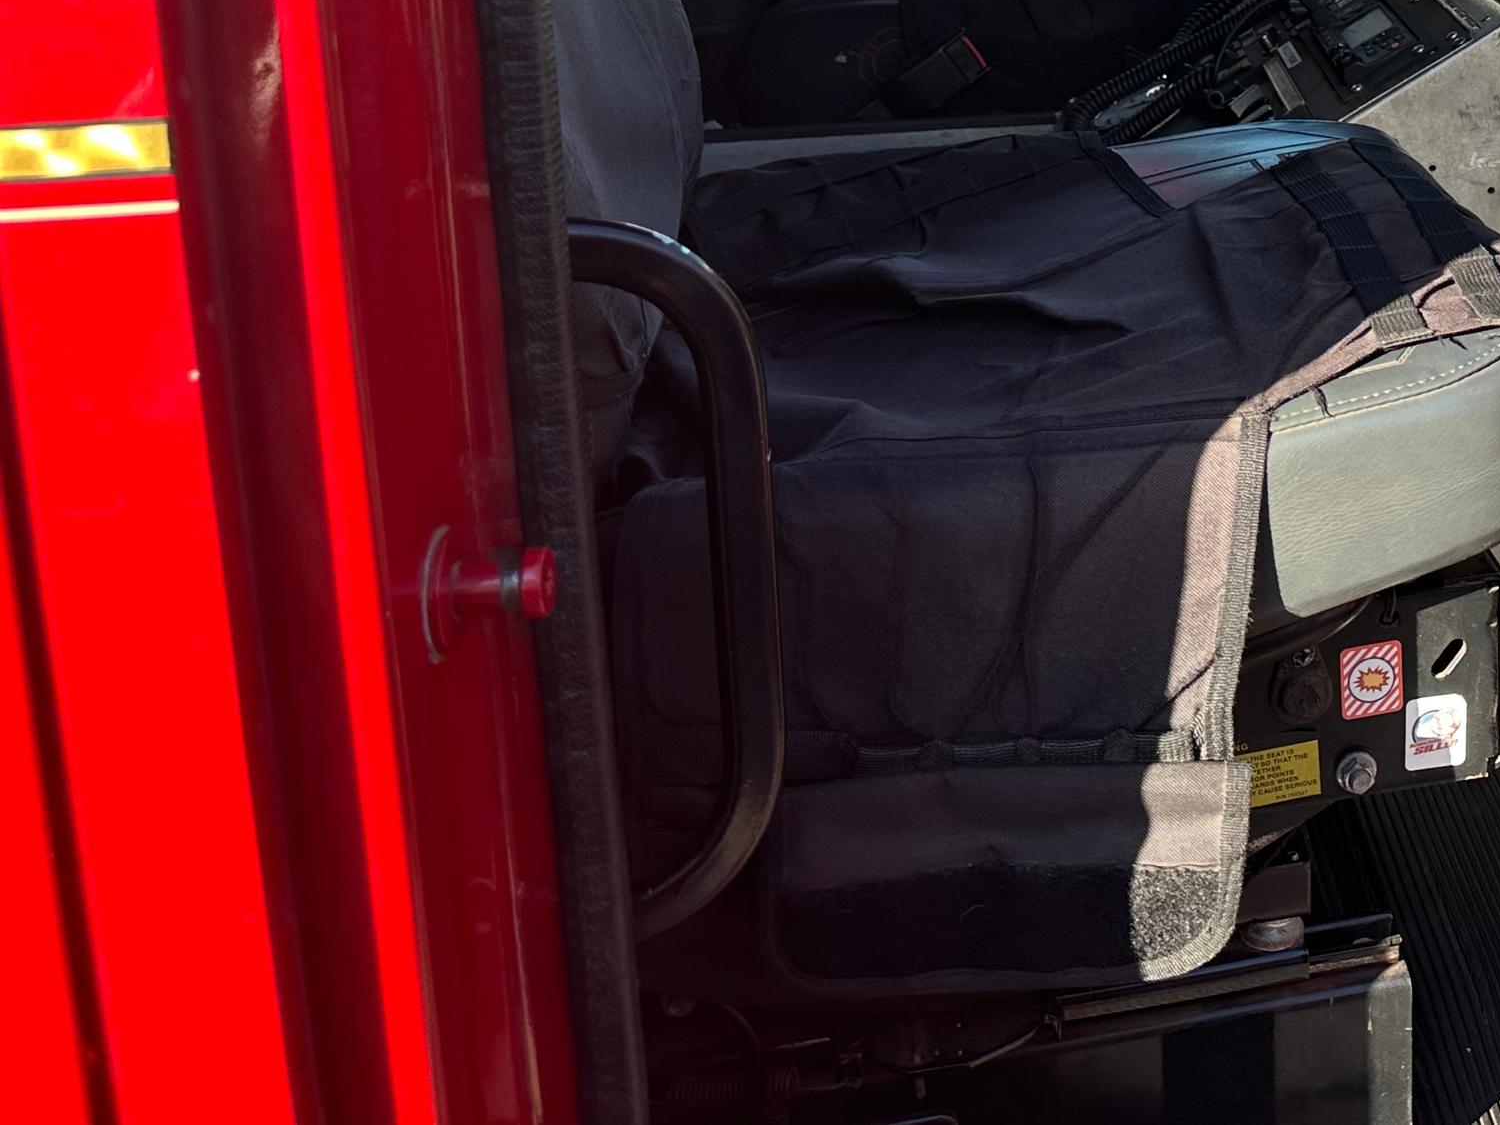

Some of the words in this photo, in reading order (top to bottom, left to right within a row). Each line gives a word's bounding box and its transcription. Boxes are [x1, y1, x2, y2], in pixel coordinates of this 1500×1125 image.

[1266, 749, 1285, 760] SEAT
[1273, 756, 1292, 766] THAT
[1293, 752, 1309, 761] THE
[1267, 769, 1295, 779] POINTS
[1277, 775, 1299, 786] WHEN
[1258, 784, 1283, 796] CAUSE
[1285, 778, 1318, 791] SERIOUS
